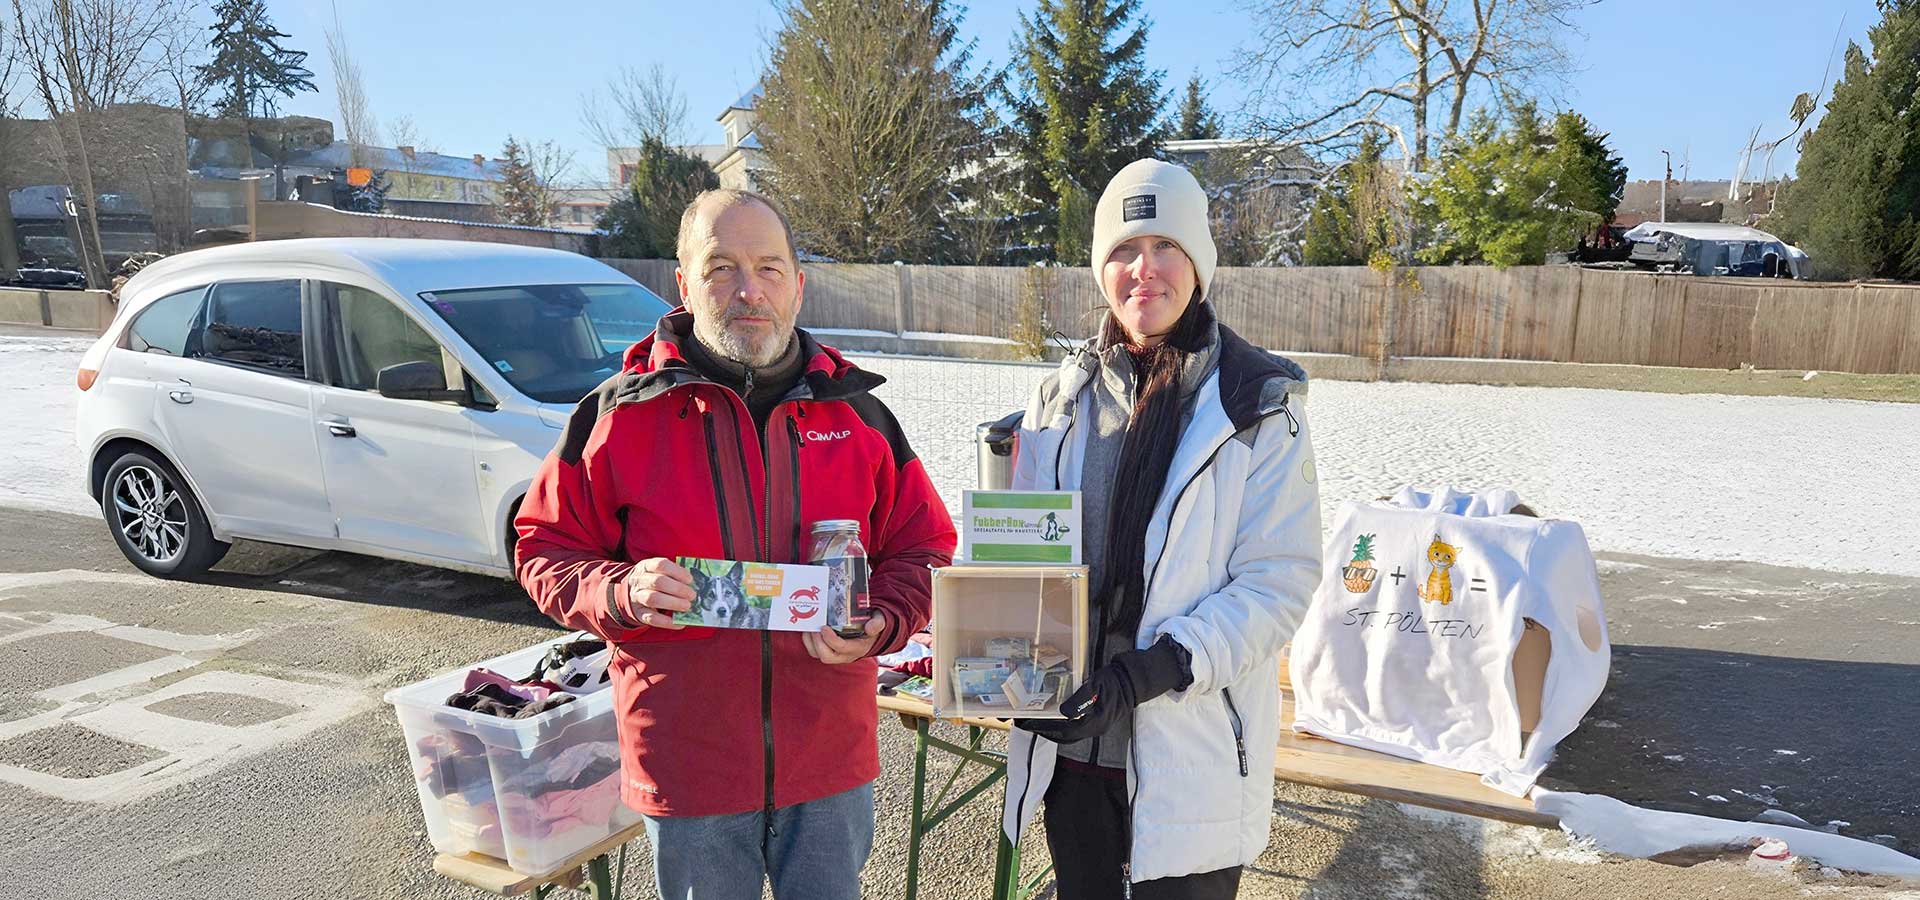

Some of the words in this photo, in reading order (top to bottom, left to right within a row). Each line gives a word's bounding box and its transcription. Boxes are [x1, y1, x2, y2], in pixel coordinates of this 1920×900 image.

[806, 430, 851, 441] CIMALP
[1342, 607, 1379, 628] ST.
[1384, 611, 1484, 639] PÖLTEN
